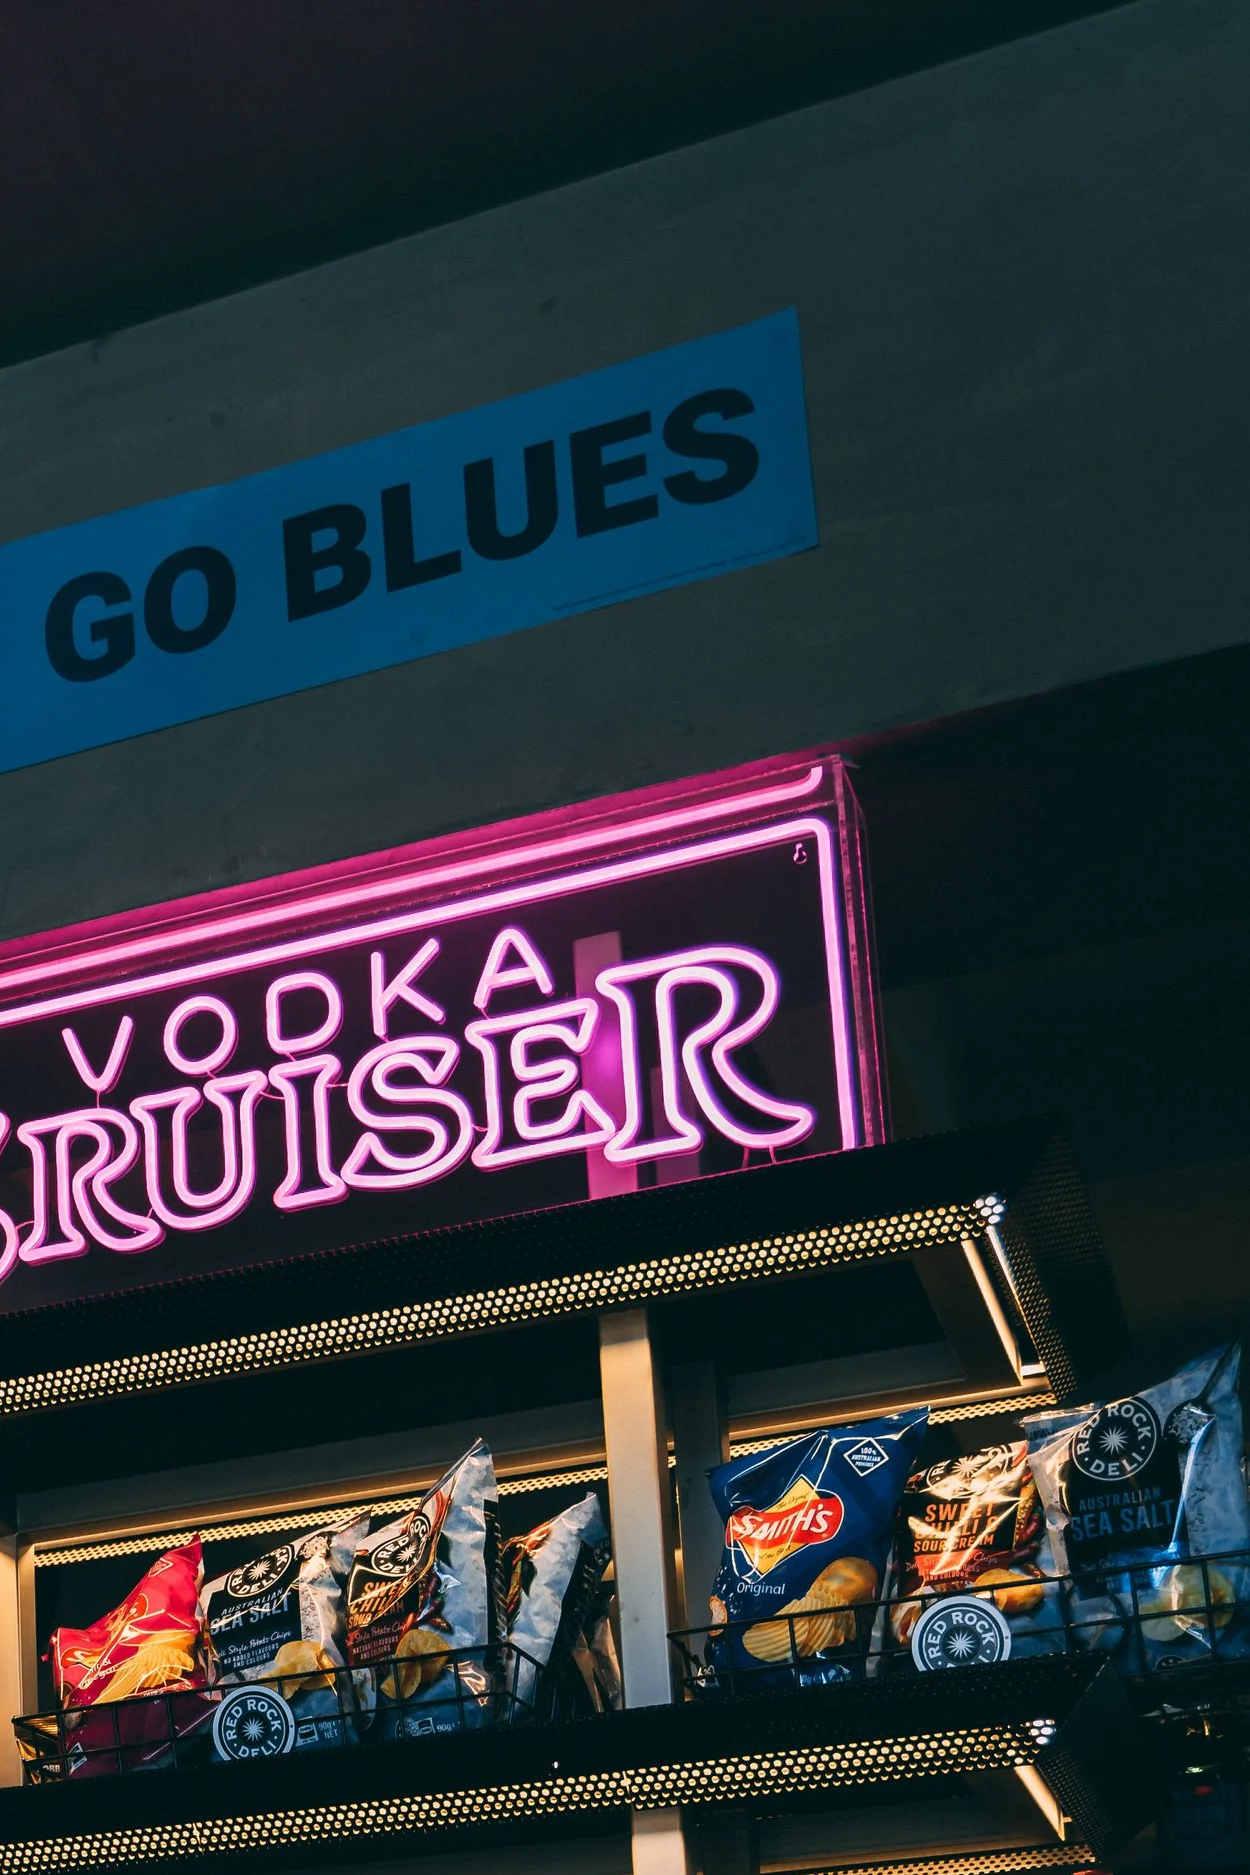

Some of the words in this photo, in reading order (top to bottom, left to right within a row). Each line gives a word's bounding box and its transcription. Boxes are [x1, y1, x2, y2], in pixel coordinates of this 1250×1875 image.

[44, 545, 237, 683] GO
[282, 387, 760, 623] BLUES
[61, 923, 554, 1094] VODKA
[1107, 1403, 1151, 1441] ROCK
[851, 1454, 881, 1463] AUSTRALIAN
[1089, 1451, 1144, 1477] DELI
[1079, 1486, 1161, 1512] AUSTRALIAN
[740, 1503, 834, 1541] SMITH'S
[1071, 1511, 1114, 1543] SEA
[1120, 1500, 1175, 1533] SALT
[378, 1536, 410, 1559] RED
[913, 1540, 948, 1553] SOUR
[237, 1572, 278, 1595] DELI
[736, 1582, 786, 1597] Original
[210, 1611, 244, 1636] SEA
[249, 1591, 292, 1624] SALT
[221, 1587, 284, 1616] AUSTRALIAN
[927, 1619, 948, 1660] RED
[951, 1611, 996, 1646] ROCK
[232, 1651, 251, 1663] ADDED
[251, 1642, 280, 1658] FLAVOURS
[245, 1652, 271, 1666] COLOURS
[225, 1705, 243, 1741] RED
[246, 1698, 282, 1732] ROCK
[237, 1739, 277, 1759] DELI
